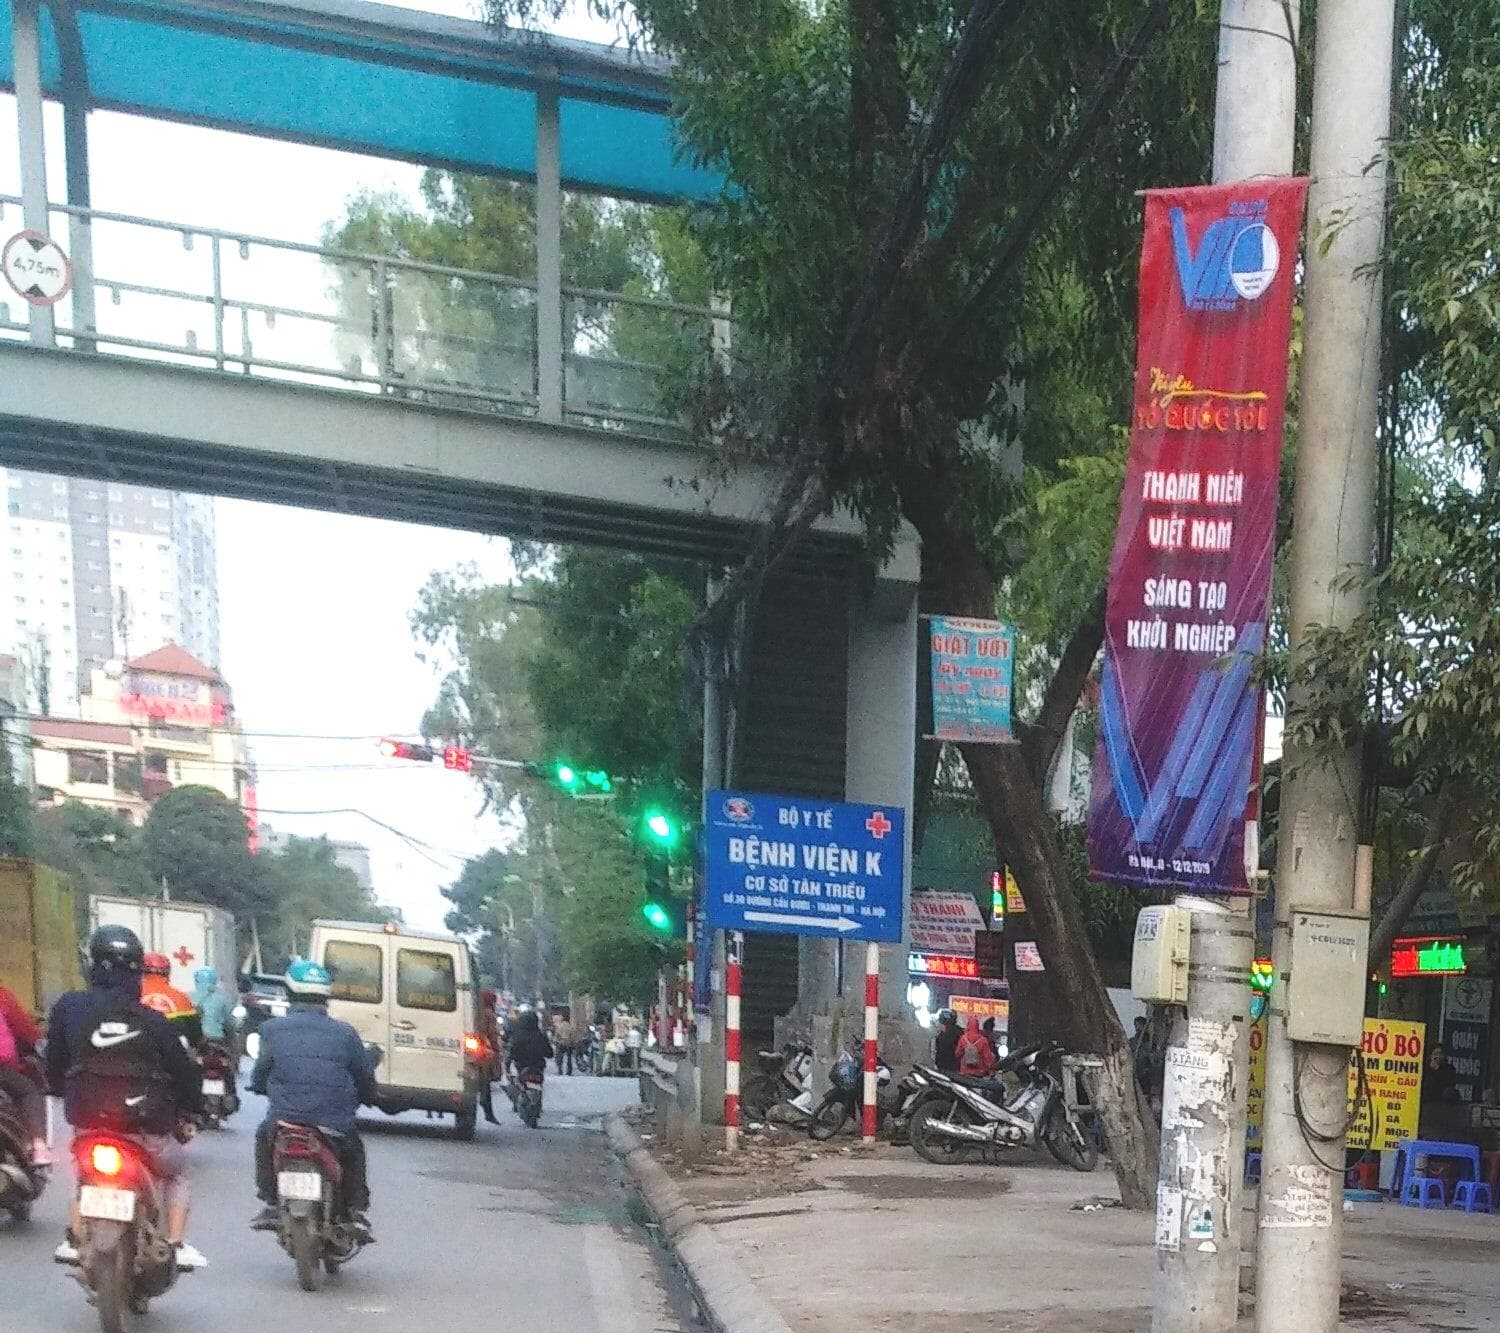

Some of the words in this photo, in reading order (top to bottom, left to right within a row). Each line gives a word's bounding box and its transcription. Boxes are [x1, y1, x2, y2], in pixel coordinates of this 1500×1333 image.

[1143, 471, 1200, 501] THANH
[1207, 469, 1244, 503] NIÊN
[1148, 512, 1185, 552] VIỆT
[1191, 519, 1233, 550] NAM
[1143, 574, 1192, 609] SÁNG
[1198, 581, 1227, 615] TẠO
[1127, 614, 1167, 649] KHỞI
[1174, 619, 1236, 657] NGHIỆP
[779, 806, 800, 829] BỘ
[803, 811, 811, 827] Y
[816, 808, 834, 829] TẾ
[729, 834, 796, 870] BỆNH
[802, 842, 859, 877] VIỆN
[865, 850, 883, 877] K
[745, 875, 766, 891] CƠ
[769, 874, 789, 893] SỞ
[792, 879, 821, 896] TÂN
[1361, 1024, 1389, 1056] HỞ
[1394, 1029, 1422, 1058] BÒ
[1384, 1059, 1419, 1075] ĐỊNH
